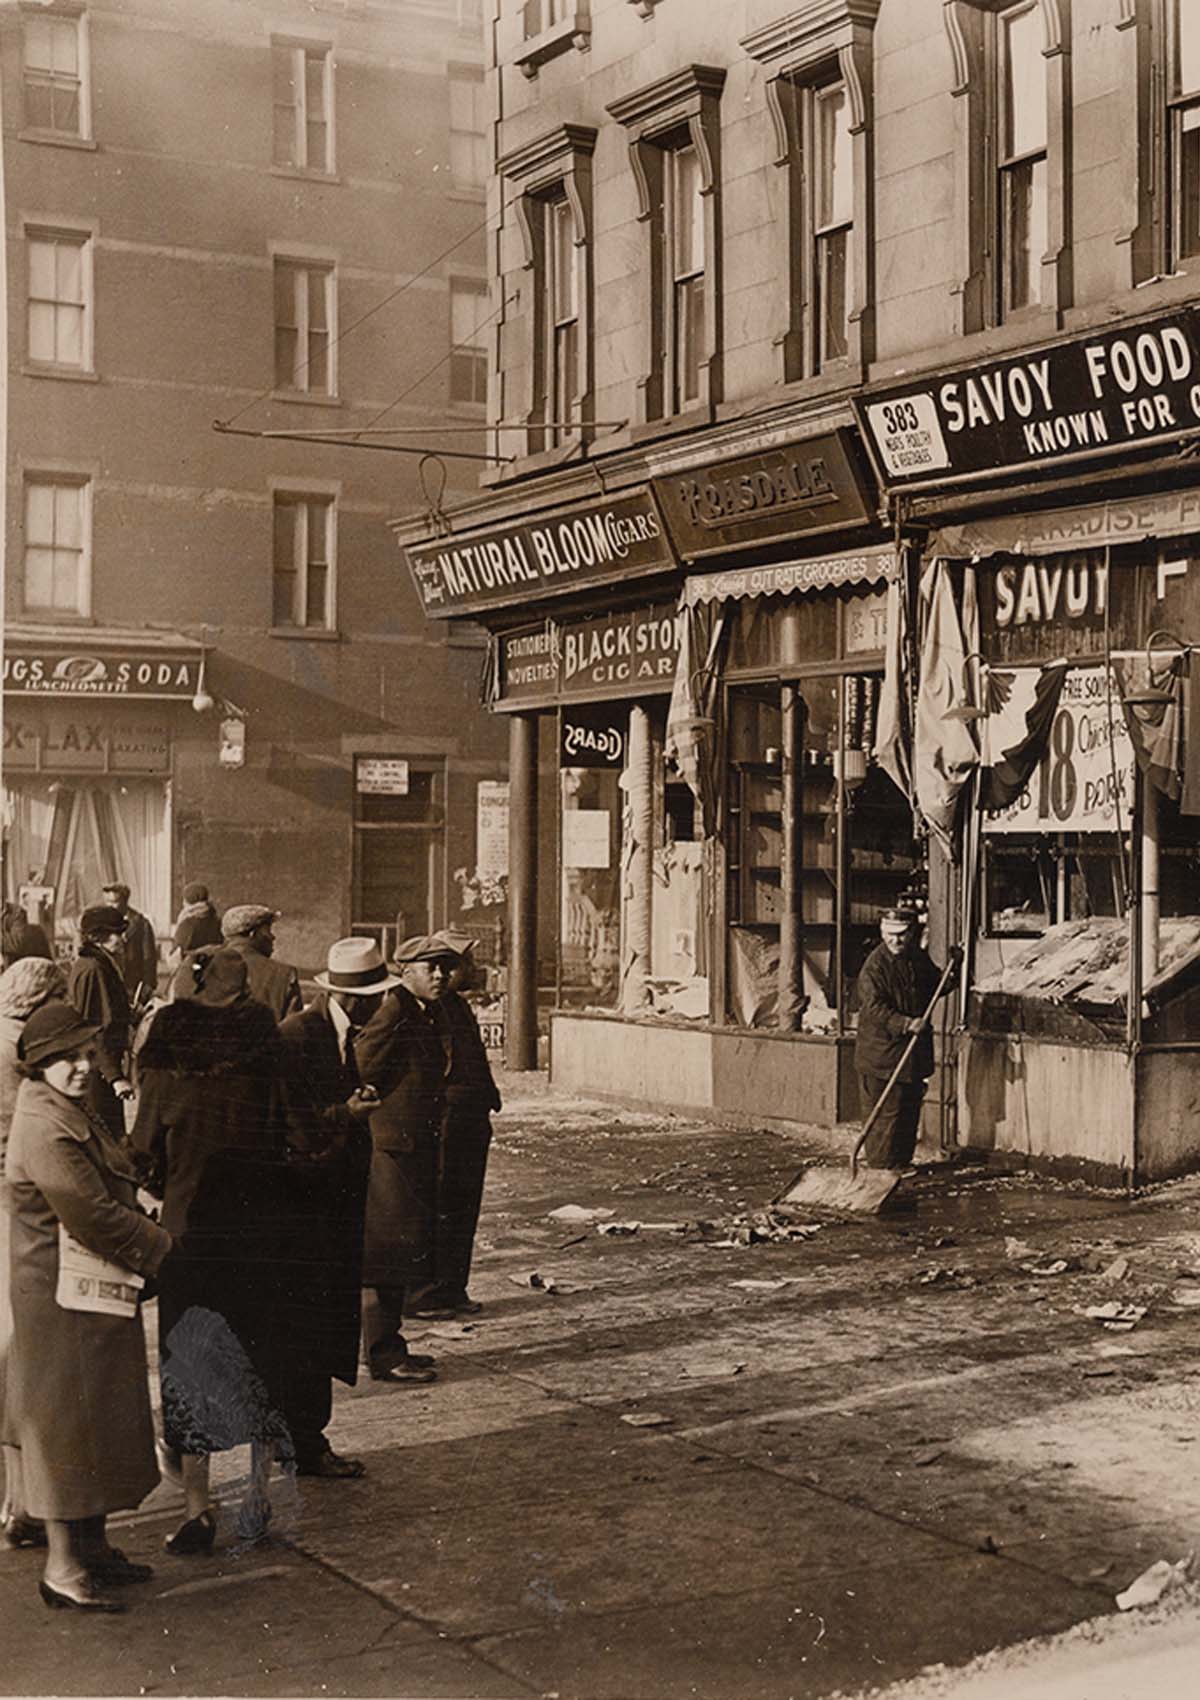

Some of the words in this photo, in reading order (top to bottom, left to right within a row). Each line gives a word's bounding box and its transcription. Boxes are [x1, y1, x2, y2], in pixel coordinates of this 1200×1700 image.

[939, 357, 1054, 432] SAVOY
[1086, 327, 1193, 397] FOOD
[883, 402, 919, 434] 383
[1023, 408, 1109, 455] KNOWN
[1123, 394, 1176, 432] FOR
[1020, 507, 1154, 541] ARADISE
[438, 535, 539, 597] NATURAL
[531, 514, 613, 576] BLOOM
[604, 512, 660, 558] CIGARS
[776, 564, 802, 585] RATE
[803, 557, 867, 582] GROCERIES
[995, 553, 1108, 627] SAVOY
[117, 662, 190, 686] SODA
[507, 662, 556, 686] NOVELTIES
[565, 616, 684, 680] BLACKSTON
[1038, 708, 1078, 822] 18
[1084, 768, 1127, 812] PORK
